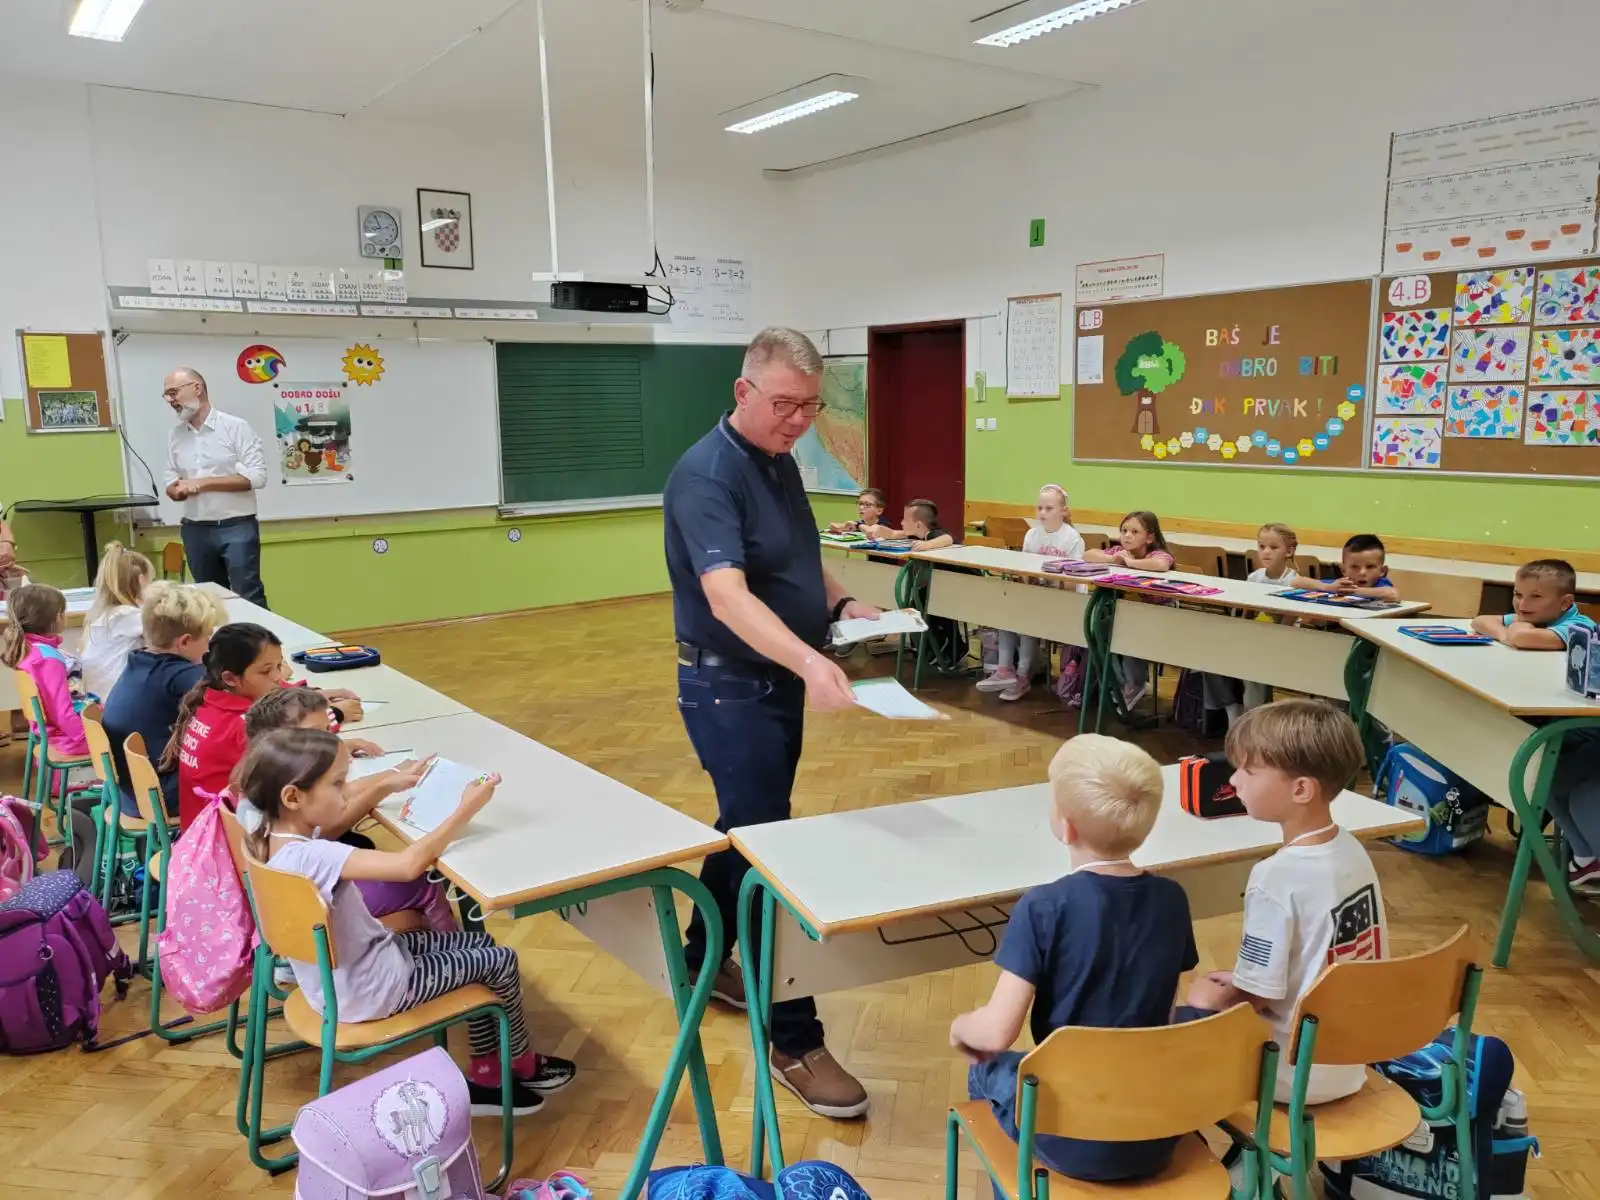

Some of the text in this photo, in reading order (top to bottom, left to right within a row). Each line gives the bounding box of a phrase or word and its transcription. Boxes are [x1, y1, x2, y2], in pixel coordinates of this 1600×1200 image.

[1391, 279, 1428, 301] 4.B
[1080, 310, 1101, 327] 1.B
[1206, 324, 1281, 346] BAŠ JE
[281, 388, 341, 399] DOBRO DOŠLI
